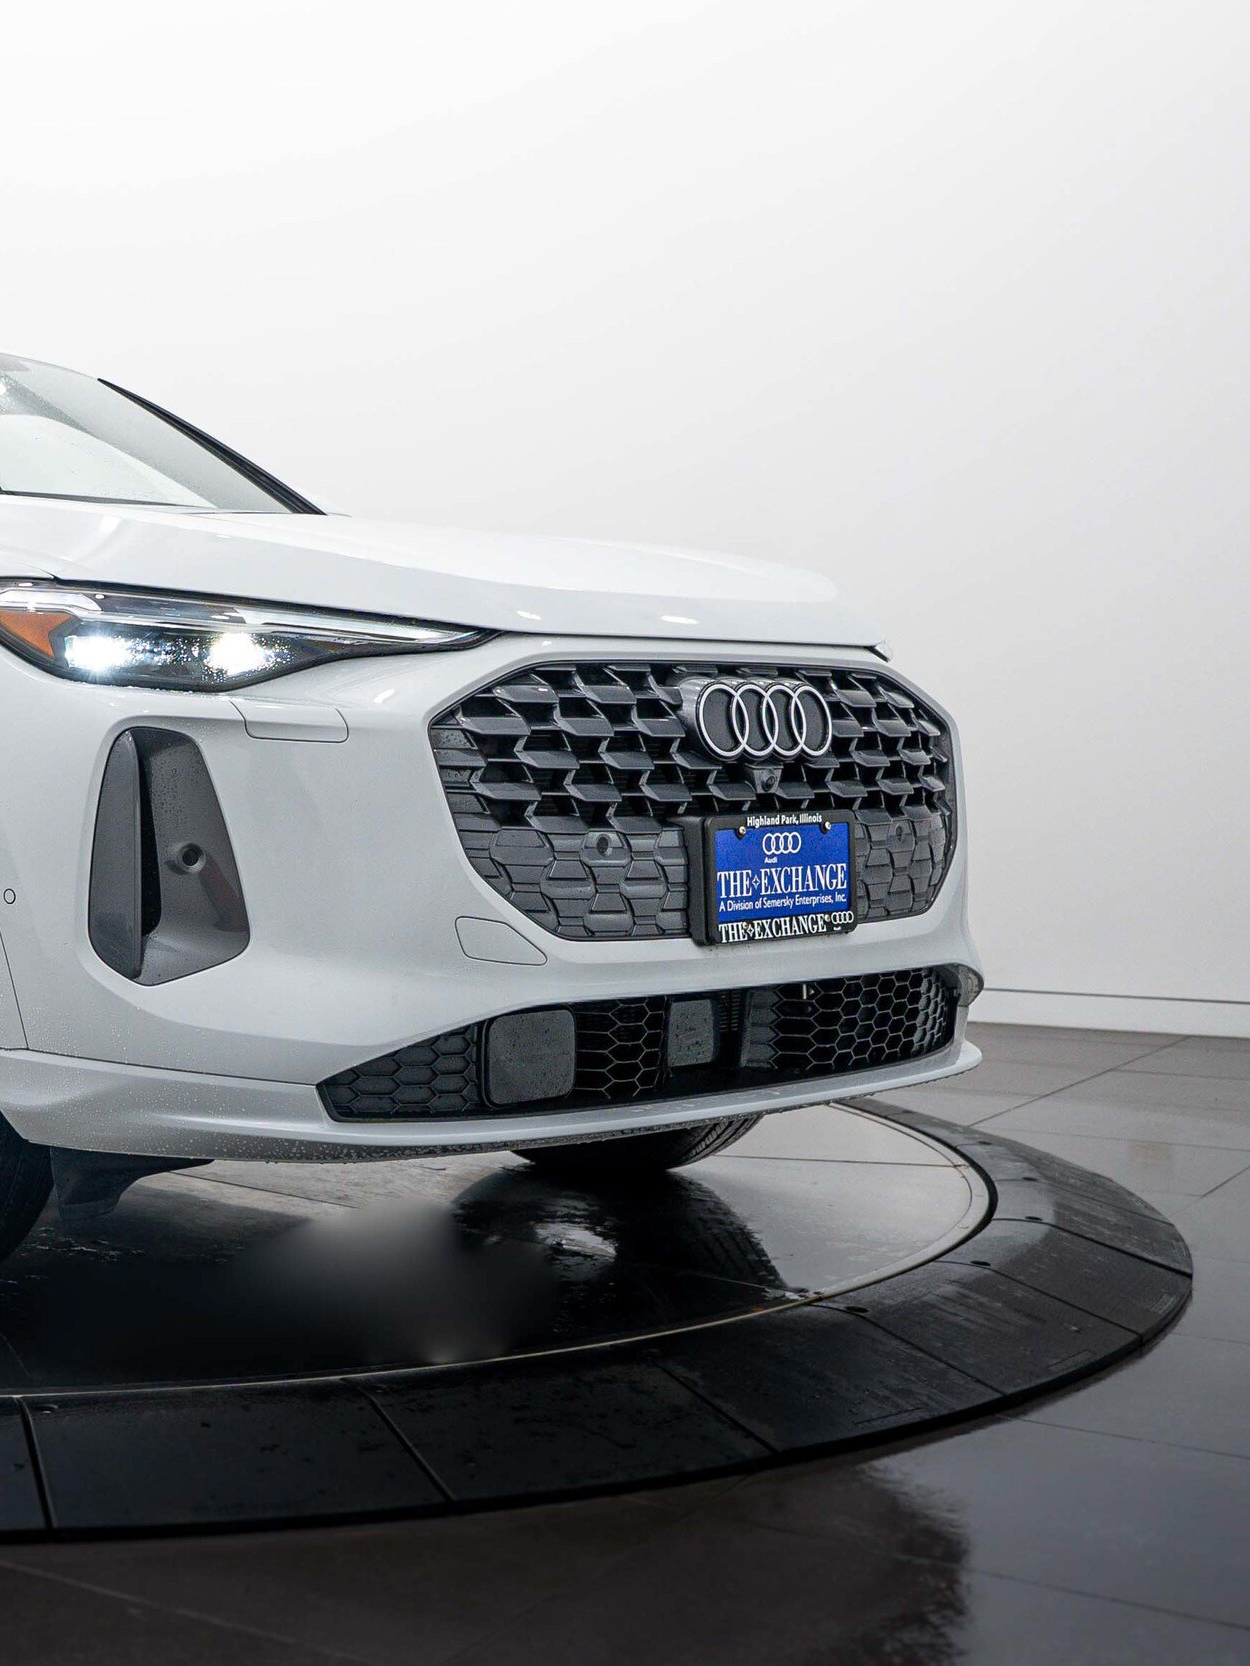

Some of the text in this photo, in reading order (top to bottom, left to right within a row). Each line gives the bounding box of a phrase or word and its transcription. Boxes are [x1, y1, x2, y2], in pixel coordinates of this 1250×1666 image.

[747, 812, 822, 828] Highland Park, Illinois
[764, 856, 778, 864] Audi
[717, 863, 847, 898] THE EXCHANGE
[719, 891, 847, 912] A Division of Semersky Enterprises, Inc.
[719, 913, 827, 943] THE EXCHANGE
